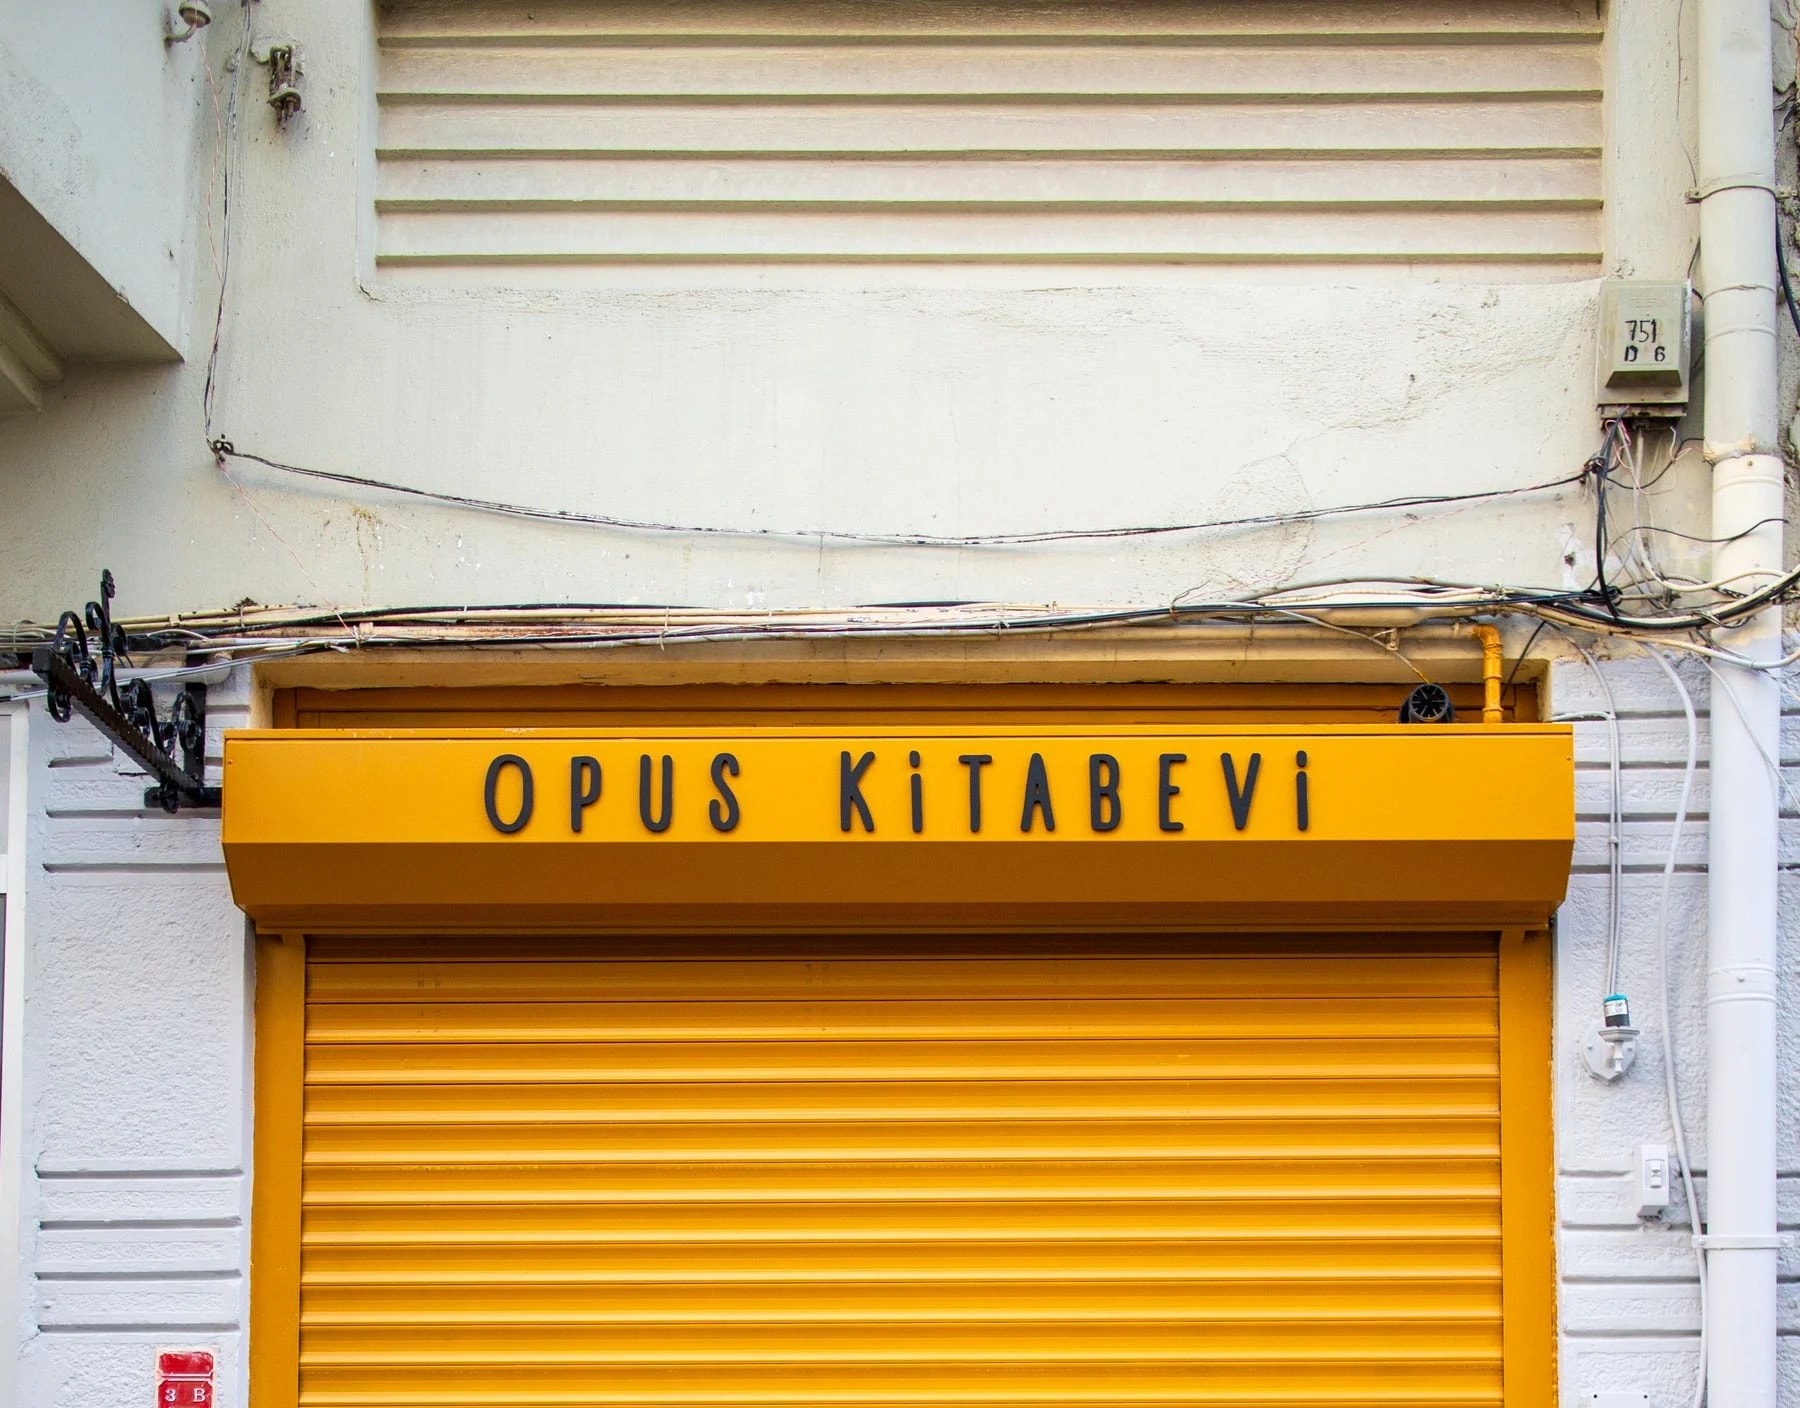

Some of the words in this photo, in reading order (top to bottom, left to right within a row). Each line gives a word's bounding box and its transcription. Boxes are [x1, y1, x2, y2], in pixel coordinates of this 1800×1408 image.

[1624, 319, 1656, 343] 751
[1624, 345, 1638, 361] D
[484, 752, 741, 833] OPUS
[165, 1388, 176, 1402] 3
[193, 1388, 205, 1402] B
